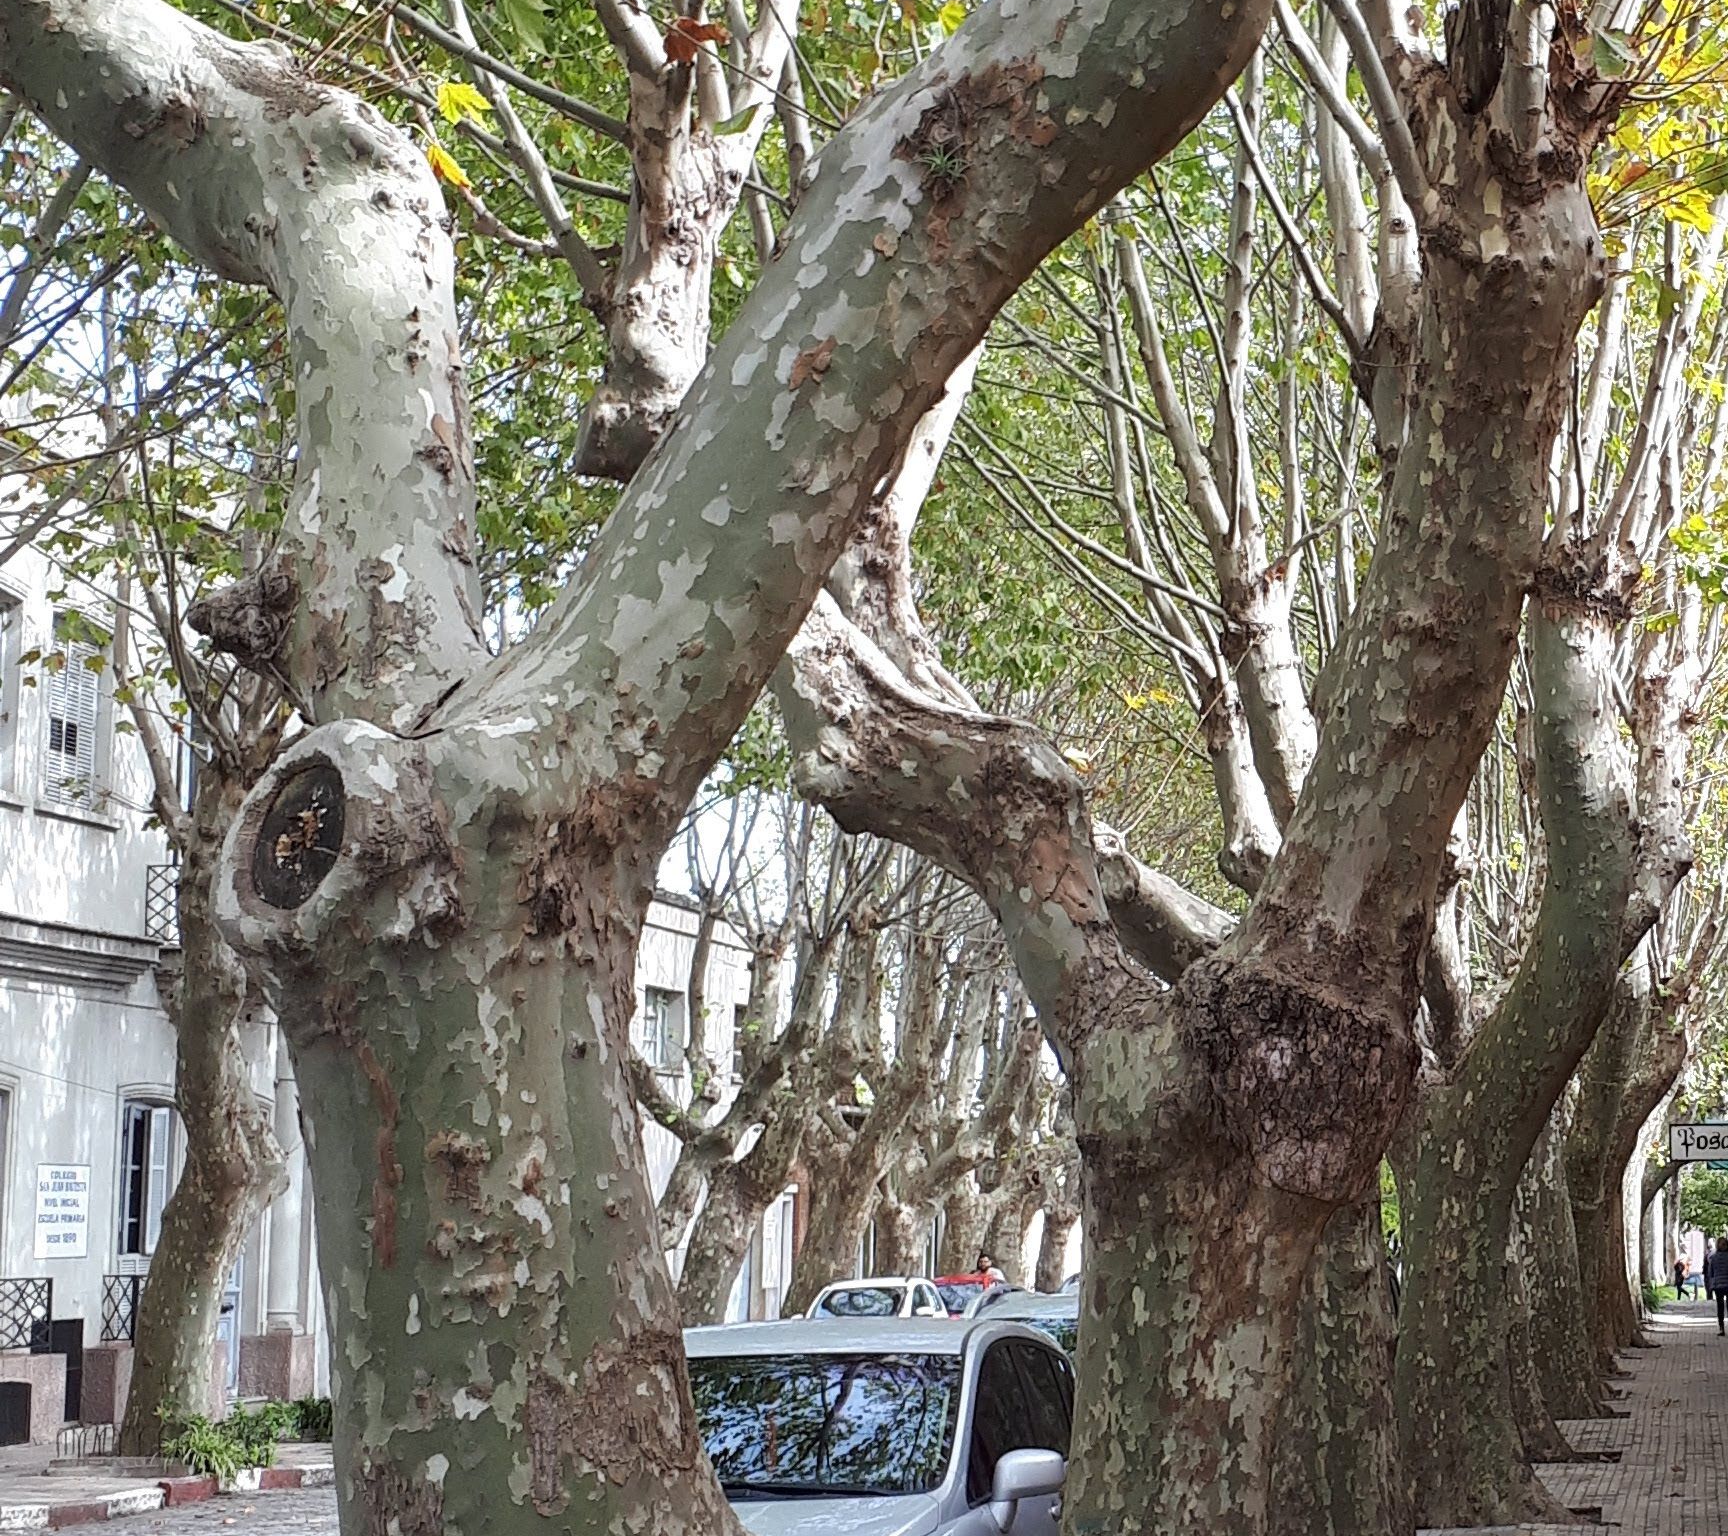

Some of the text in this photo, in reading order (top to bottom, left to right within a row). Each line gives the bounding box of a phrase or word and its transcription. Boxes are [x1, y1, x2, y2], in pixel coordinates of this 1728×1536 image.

[50, 1170, 77, 1180] COLEGIO
[38, 1213, 85, 1224] ESCUELA PRIMARIA
